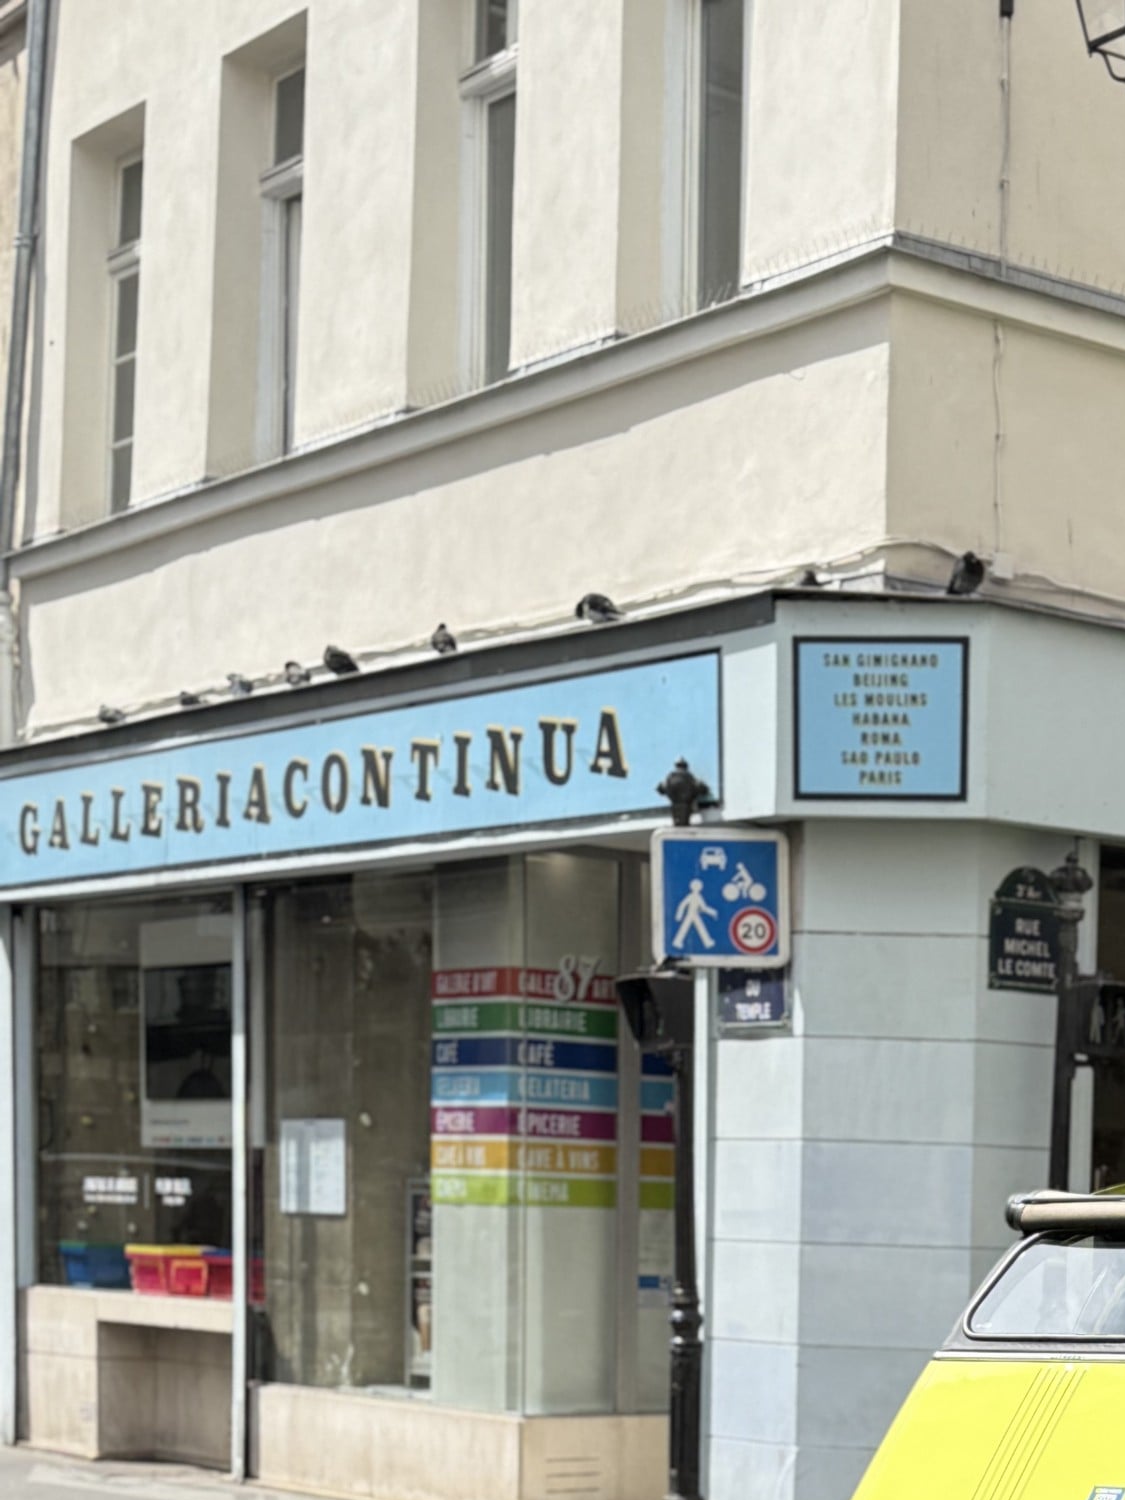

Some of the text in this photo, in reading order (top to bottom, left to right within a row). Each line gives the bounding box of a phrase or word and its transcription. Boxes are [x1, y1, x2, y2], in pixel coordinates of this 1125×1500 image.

[823, 654, 939, 668] SAN GIMIGNANO
[853, 673, 909, 687] BEIJING
[834, 693, 927, 707] LES MOULINS
[852, 713, 909, 726] HABANA
[860, 732, 902, 745] ROMA
[875, 751, 920, 765] PAULO
[859, 771, 902, 784] PARIS
[742, 923, 766, 940] 20
[1015, 918, 1041, 936] RUE
[1004, 938, 1051, 958] MICHEL
[998, 958, 1056, 979] LE COMTE
[553, 954, 600, 1001] 87
[735, 1002, 771, 1021] TEMPLE
